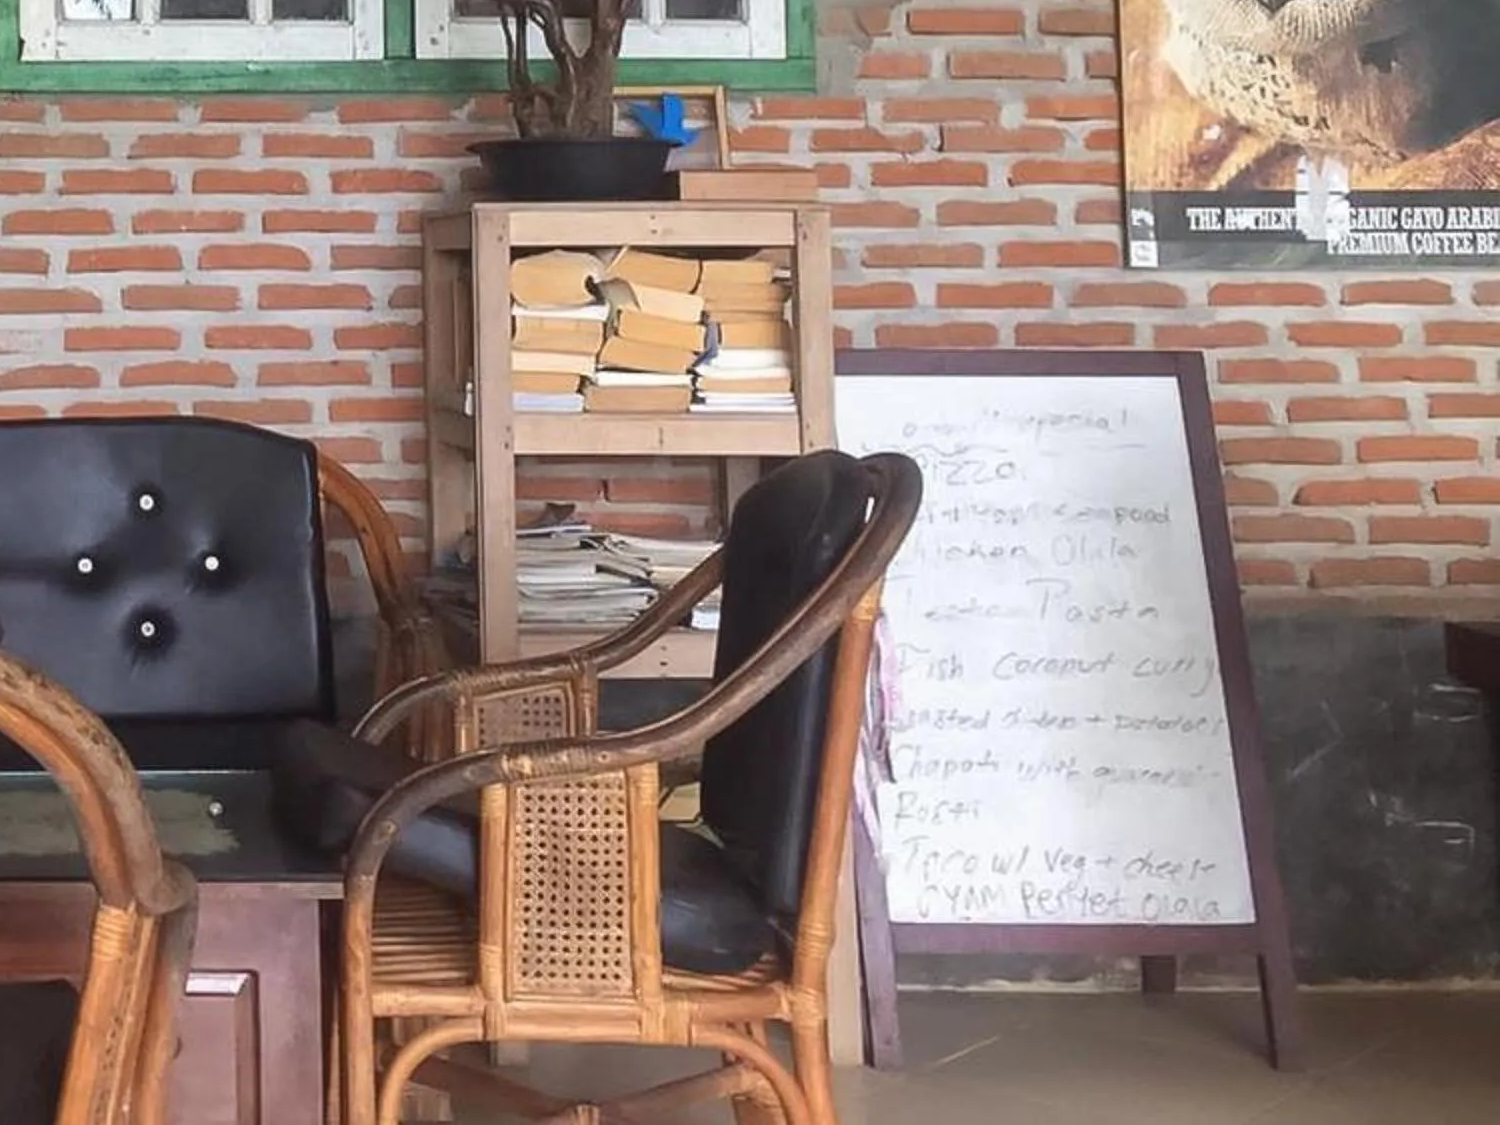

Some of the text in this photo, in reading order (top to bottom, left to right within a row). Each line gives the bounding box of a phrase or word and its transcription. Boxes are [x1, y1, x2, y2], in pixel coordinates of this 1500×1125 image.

[1185, 207, 1221, 231] THE
[1400, 207, 1445, 230] GAYO
[1326, 231, 1500, 255] PREMIUM COFFEE BE
